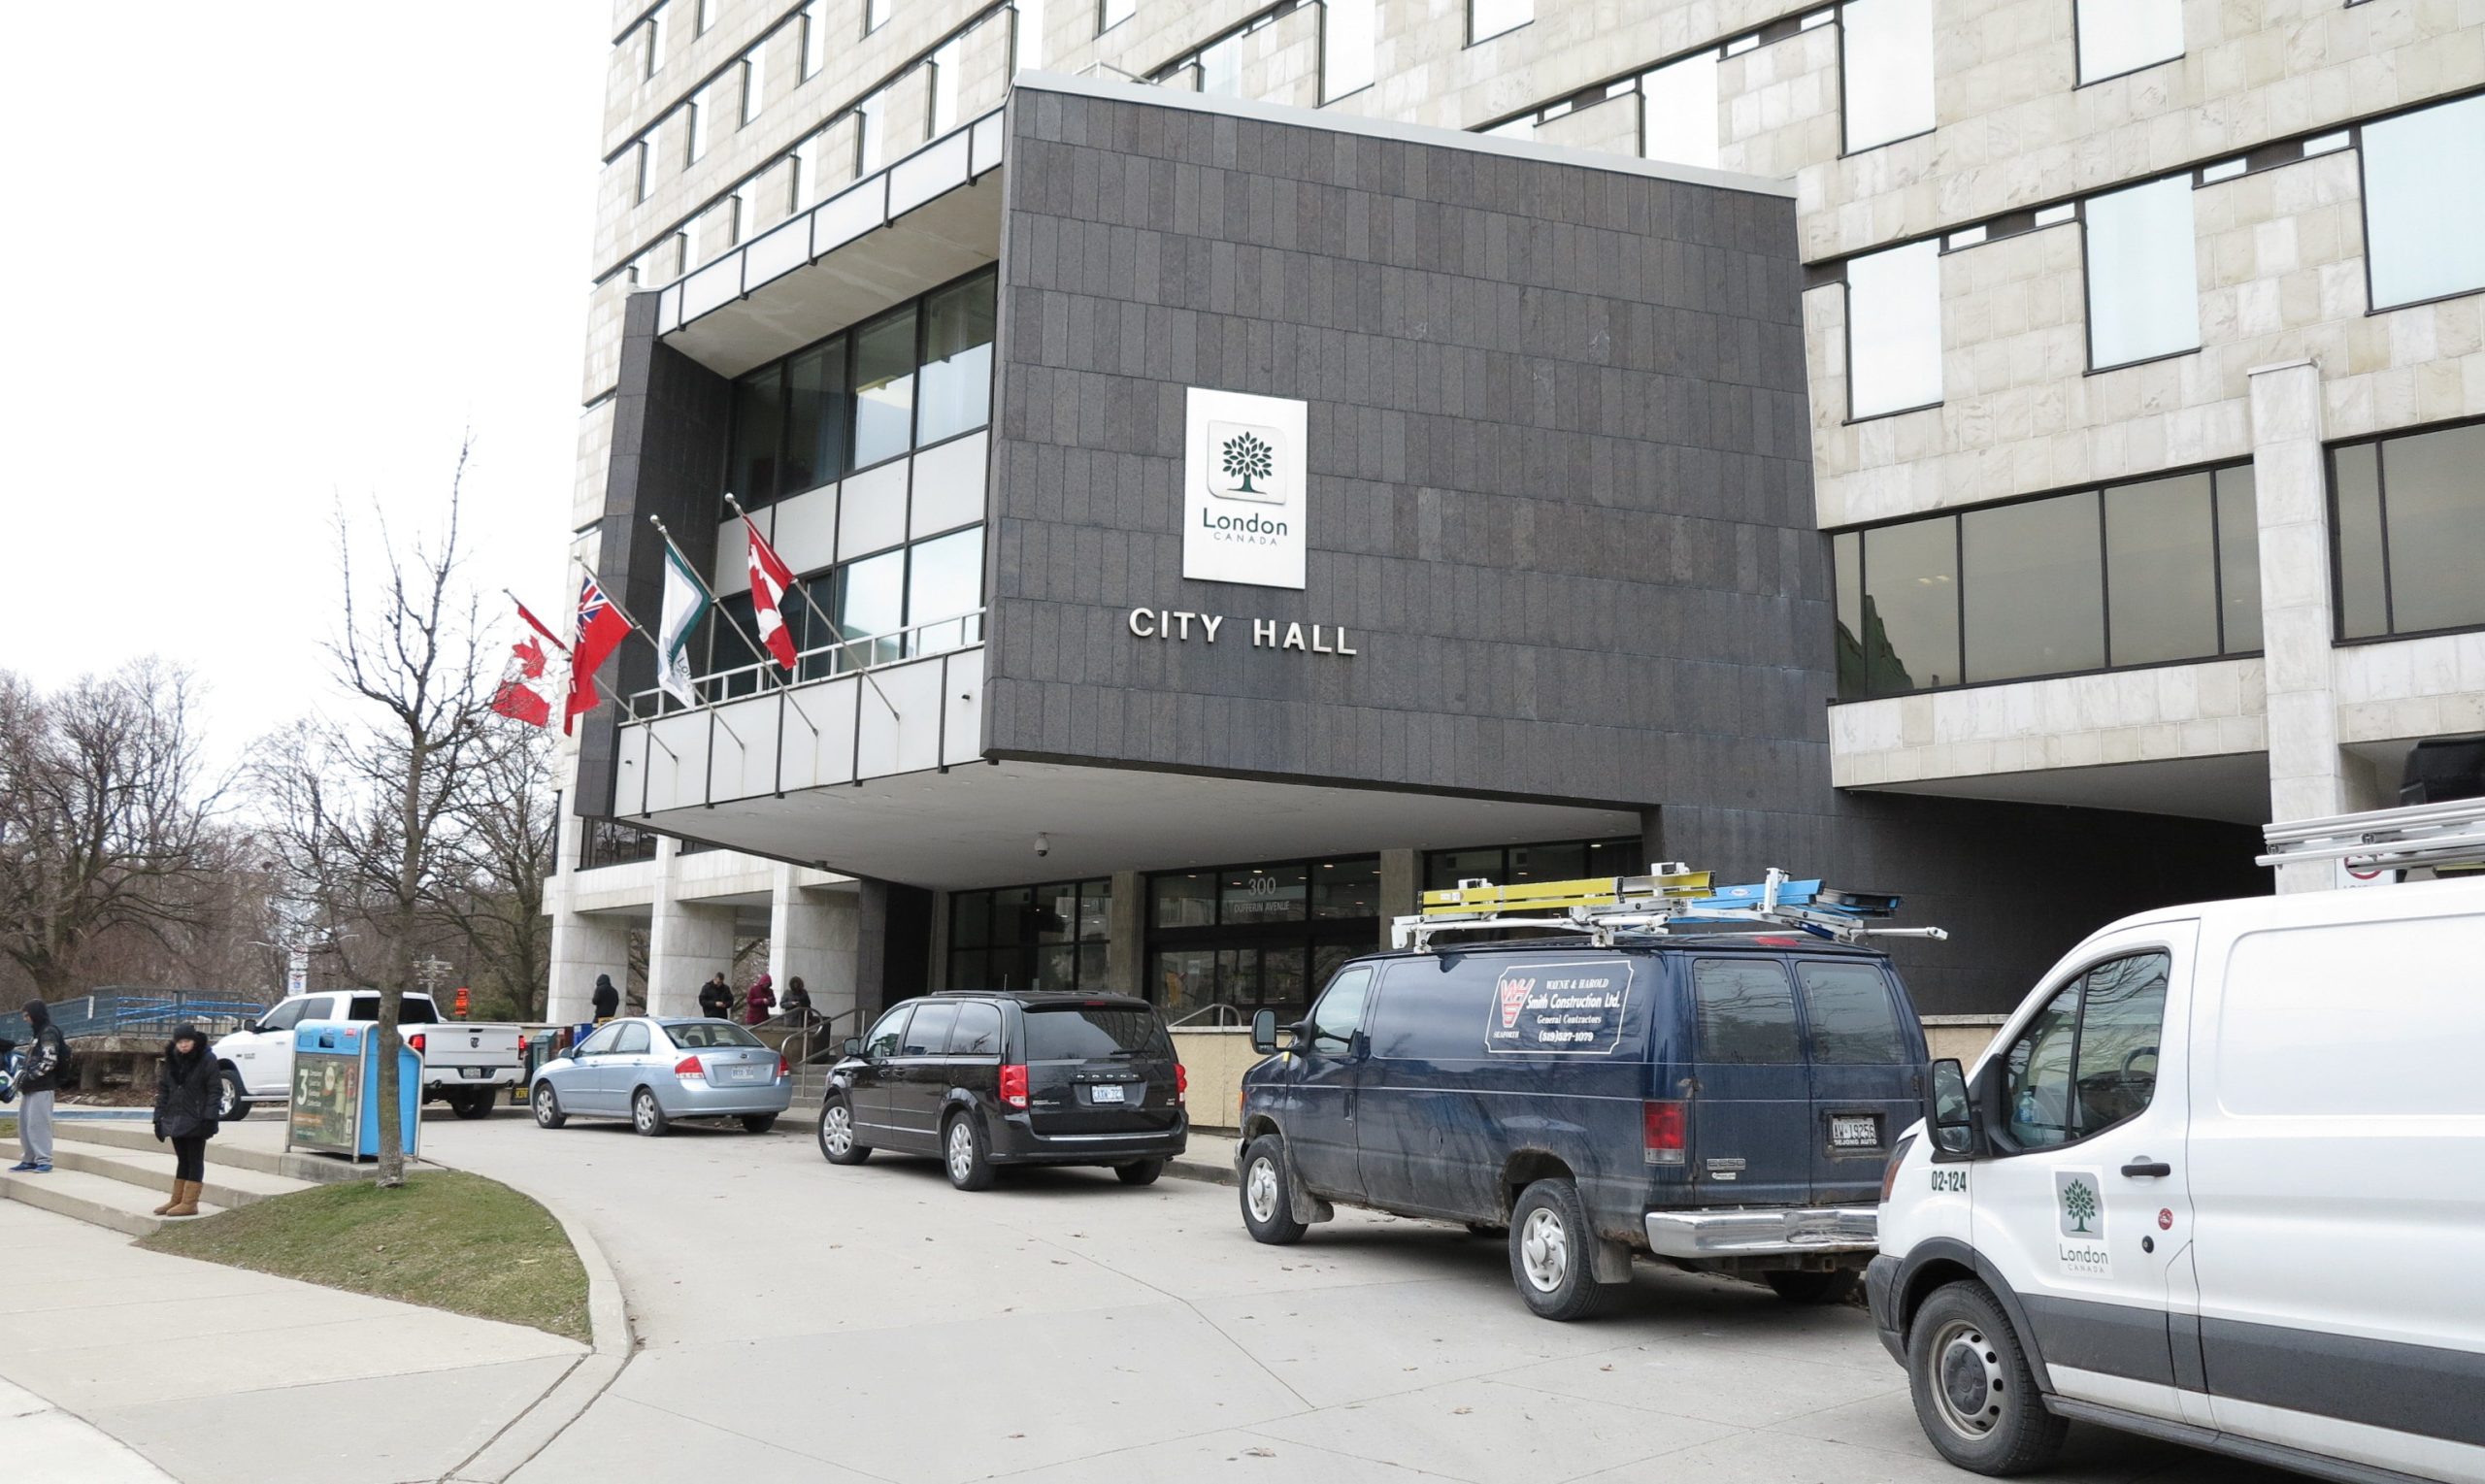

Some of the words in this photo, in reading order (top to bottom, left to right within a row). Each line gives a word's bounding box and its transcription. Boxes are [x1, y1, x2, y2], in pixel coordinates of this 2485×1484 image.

[1203, 508, 1288, 536] London
[1213, 531, 1278, 545] CANADA
[1129, 607, 1223, 643] CITY
[1253, 618, 1357, 656] HALL
[1248, 876, 1276, 897] 300
[1234, 902, 1263, 913] DUFFERIN
[1265, 900, 1290, 911] AVENUE
[1546, 979, 1569, 990] WAYNE
[1571, 979, 1577, 989] &
[1578, 977, 1609, 989] HAROLD
[1526, 992, 1548, 1009] Smith
[1550, 992, 1603, 1009] Construction
[1605, 990, 1621, 1008] Ltd.
[1537, 1013, 1562, 1024] General
[1563, 1014, 1603, 1025] Contractors
[1931, 1169, 1967, 1192] 02-124
[2059, 1242, 2108, 1265] London
[2068, 1264, 2105, 1274] CANADA
